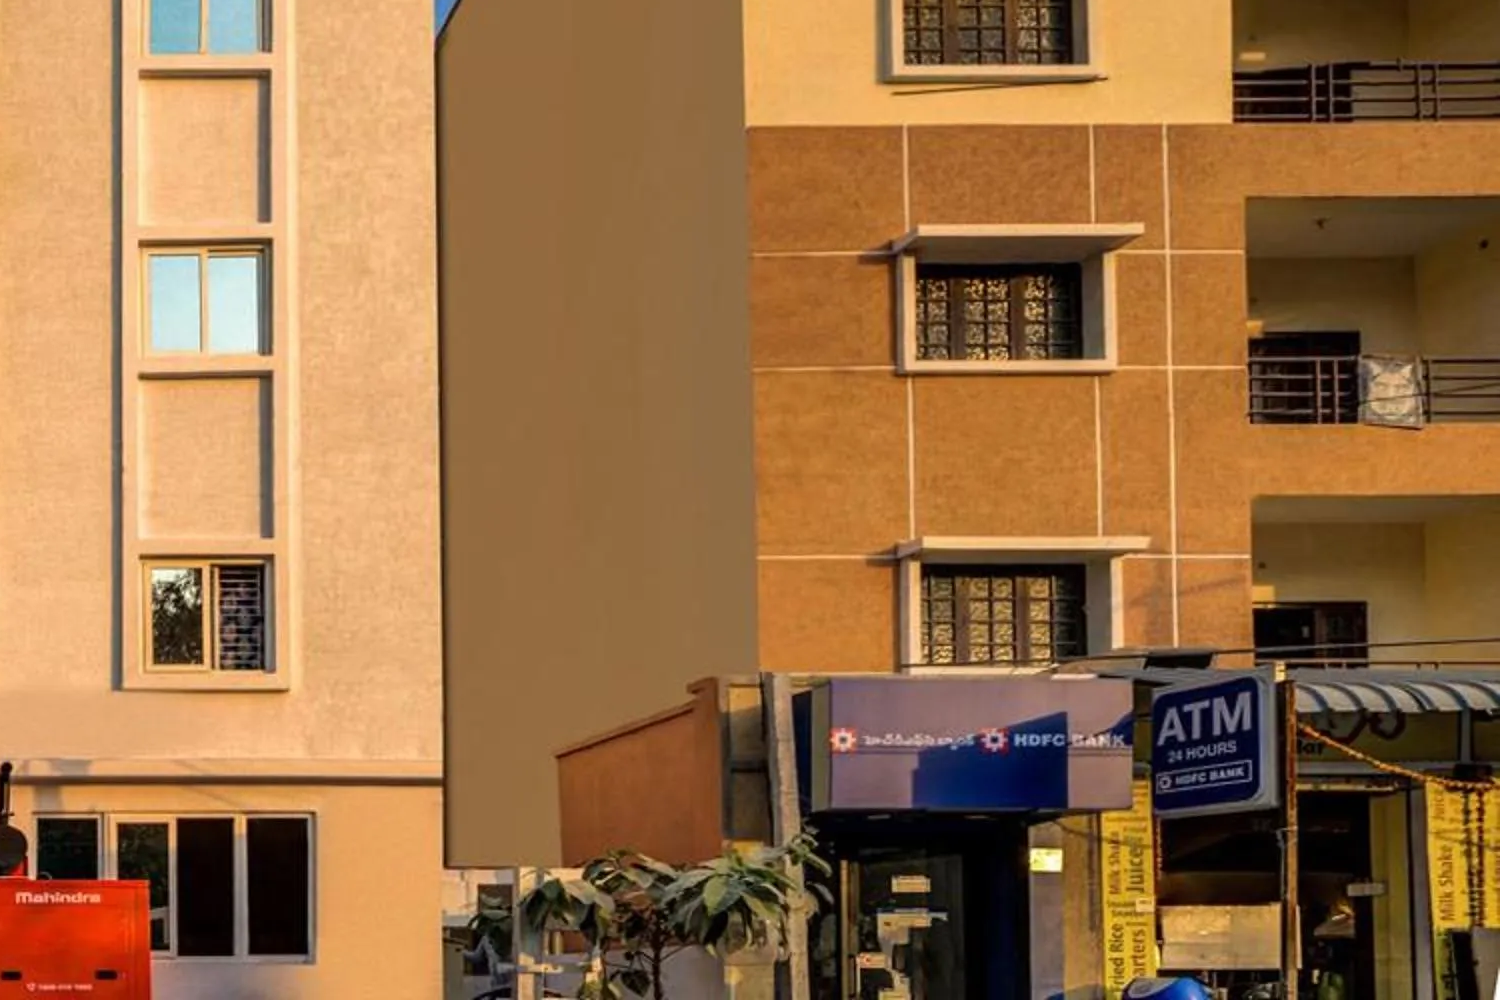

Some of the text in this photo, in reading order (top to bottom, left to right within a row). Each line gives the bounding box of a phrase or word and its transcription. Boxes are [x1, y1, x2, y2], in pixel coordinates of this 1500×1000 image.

[1157, 692, 1252, 746] ATM
[1014, 734, 1126, 747] HDFC BANK
[1167, 740, 1237, 764] 24 HOURS
[1175, 767, 1244, 785] HDFC BANK
[1437, 845, 1453, 887] Shake
[1439, 891, 1455, 921] Milk
[1108, 923, 1124, 953] Rice
[1130, 929, 1146, 977] arters
